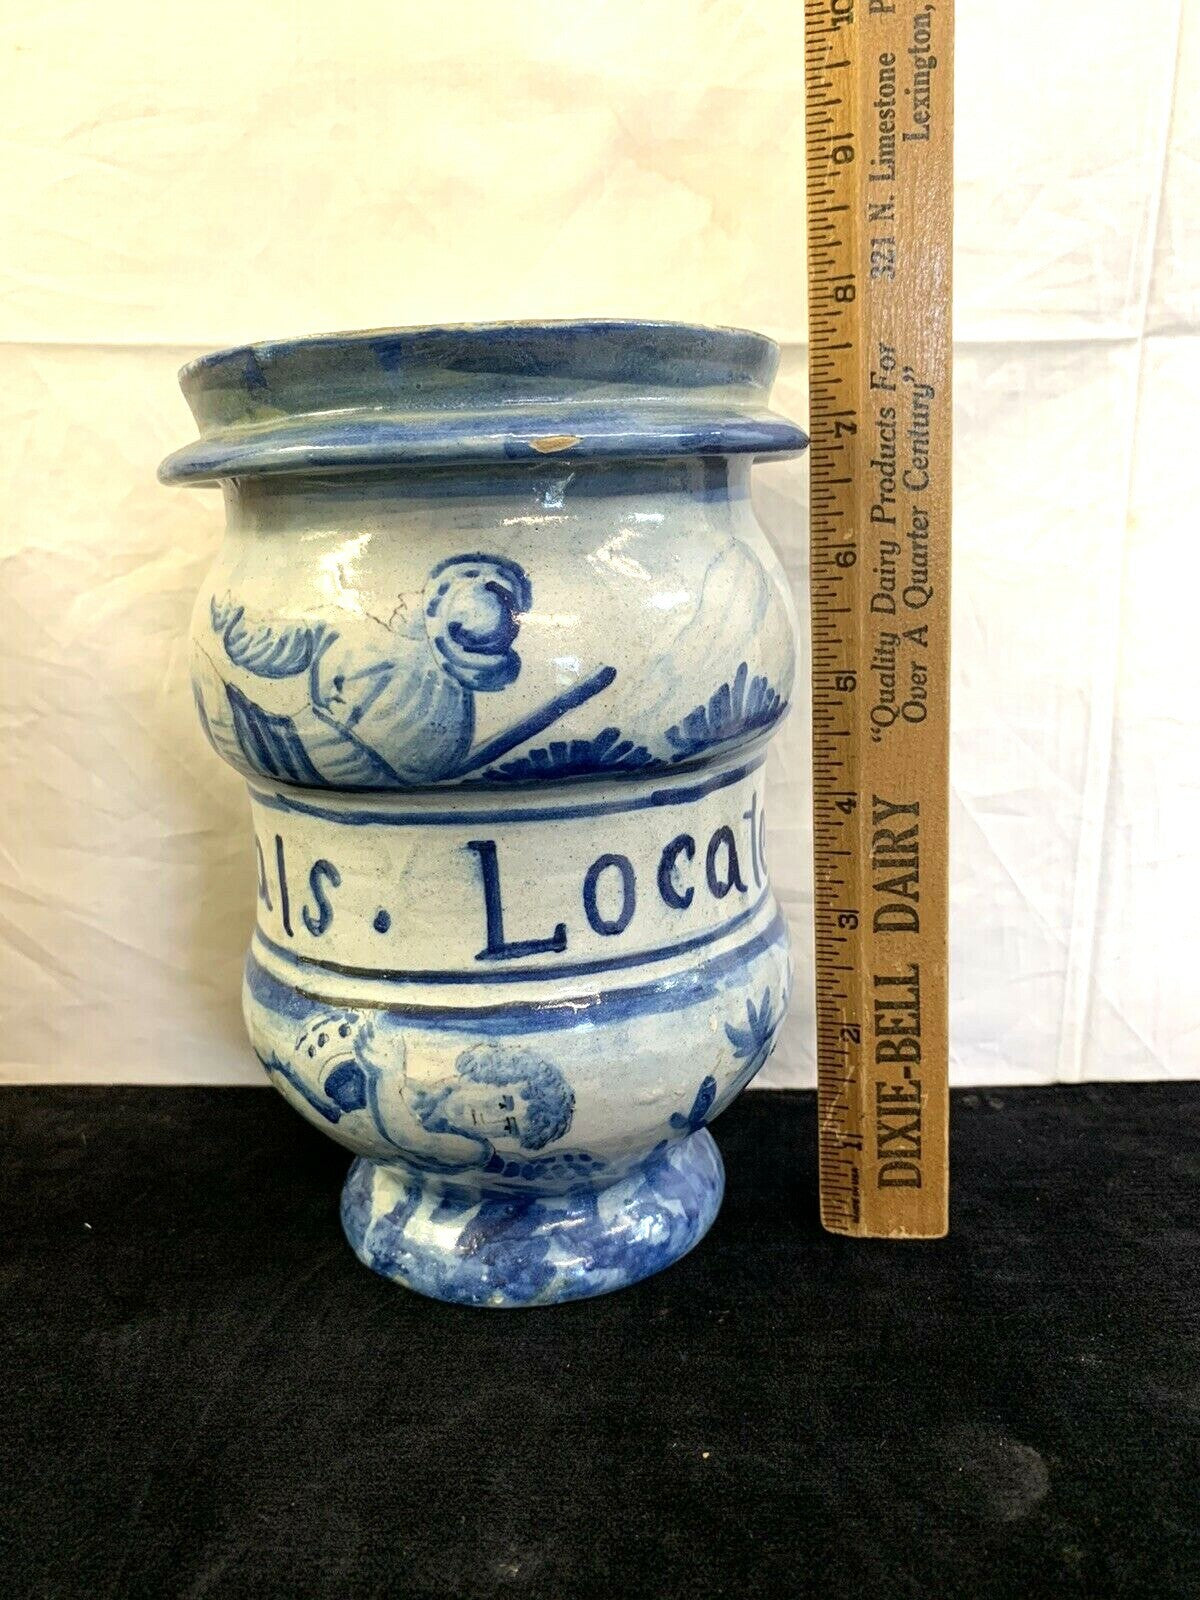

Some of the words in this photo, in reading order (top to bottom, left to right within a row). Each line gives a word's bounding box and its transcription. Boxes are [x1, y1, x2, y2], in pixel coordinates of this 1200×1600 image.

[902, 4, 938, 142] Lexington,
[869, 52, 896, 181] Limestone
[831, 145, 855, 165] 9
[869, 194, 895, 222] N.
[870, 236, 896, 280] 321
[834, 284, 856, 303] 8
[870, 342, 896, 391] For
[834, 421, 857, 438] 7
[902, 366, 935, 491] Century”
[870, 407, 896, 525] Products
[835, 551, 857, 568] 6
[870, 540, 901, 615] Dairy
[902, 505, 934, 610] Quarter
[902, 625, 928, 648] A
[835, 675, 857, 692] 5
[870, 632, 900, 743] “Quality
[901, 661, 928, 724] Over
[835, 798, 857, 815] 4
[872, 795, 920, 933] DAIRY
[838, 914, 859, 930] 3
[839, 1028, 861, 1044] 2
[873, 963, 922, 1188] DIXIE-BELL
[841, 1141, 863, 1151] 1
